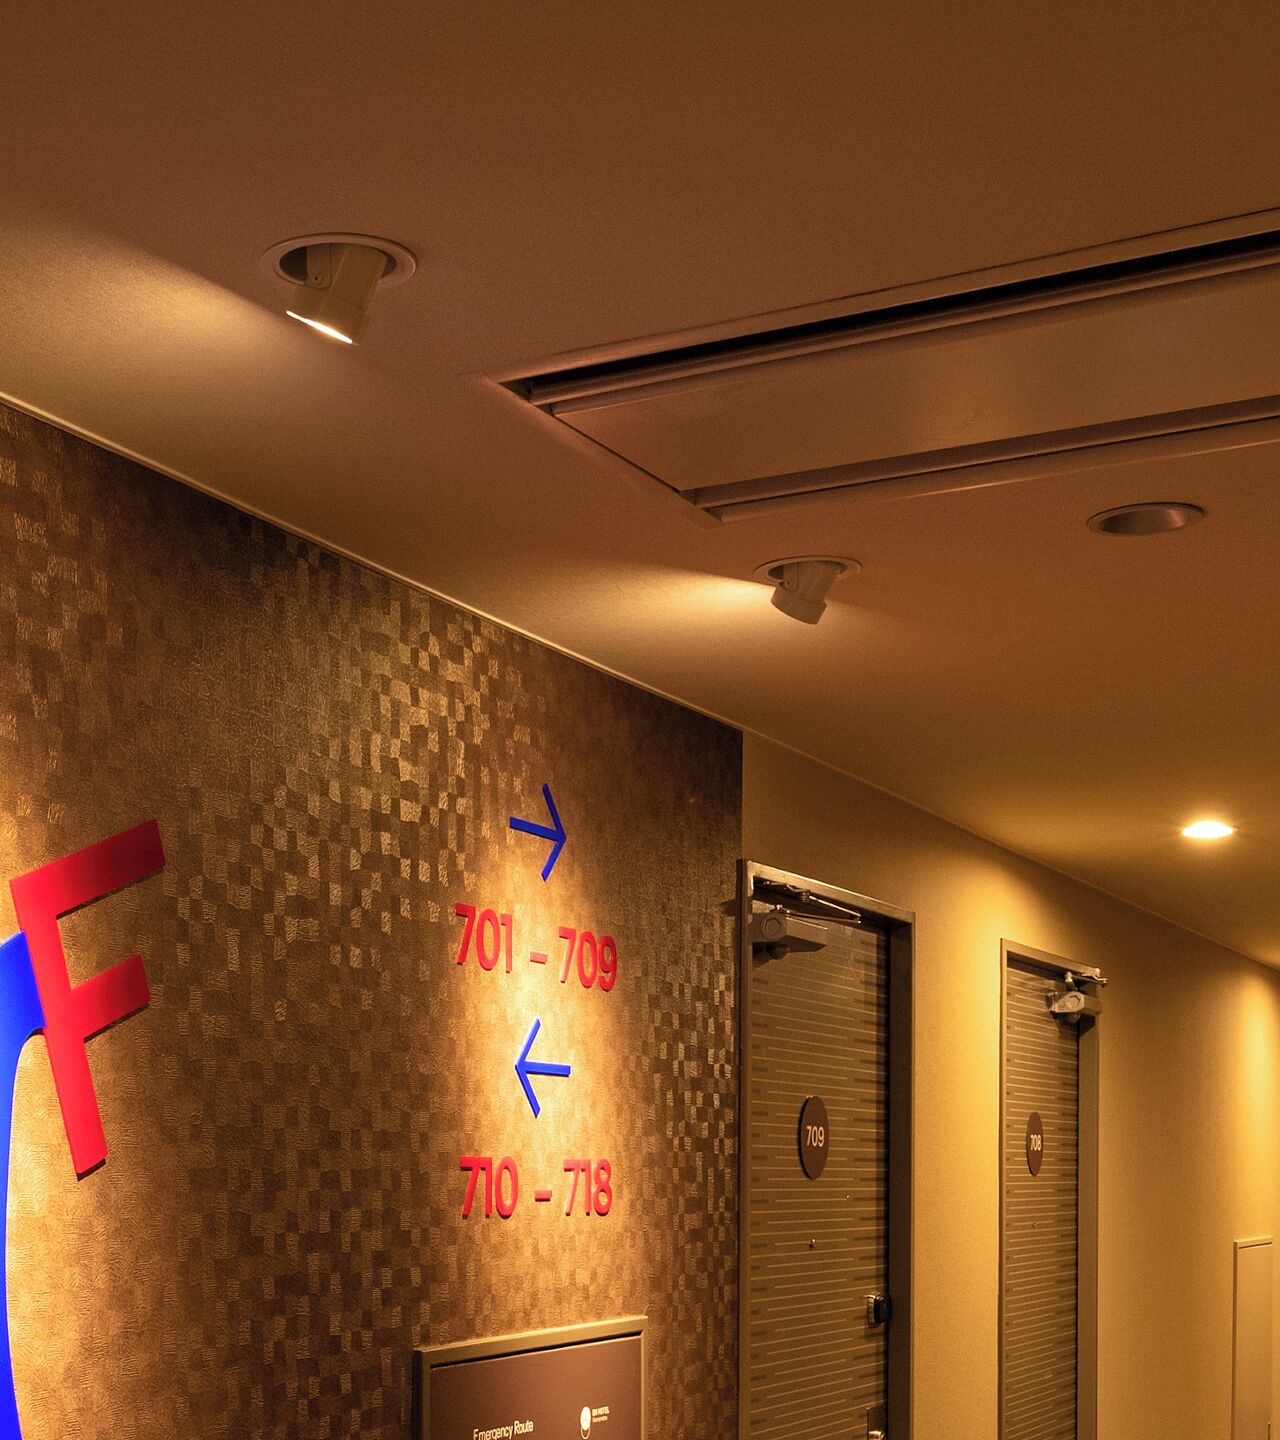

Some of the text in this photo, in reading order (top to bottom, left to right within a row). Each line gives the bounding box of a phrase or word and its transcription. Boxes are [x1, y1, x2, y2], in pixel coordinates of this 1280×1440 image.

[454, 903, 513, 974] 701
[558, 926, 618, 991] 709
[805, 1124, 826, 1149] 709
[1029, 1133, 1043, 1152] 708
[459, 1155, 519, 1218] 710
[563, 1157, 613, 1217] 718
[513, 1420, 534, 1435] Route
